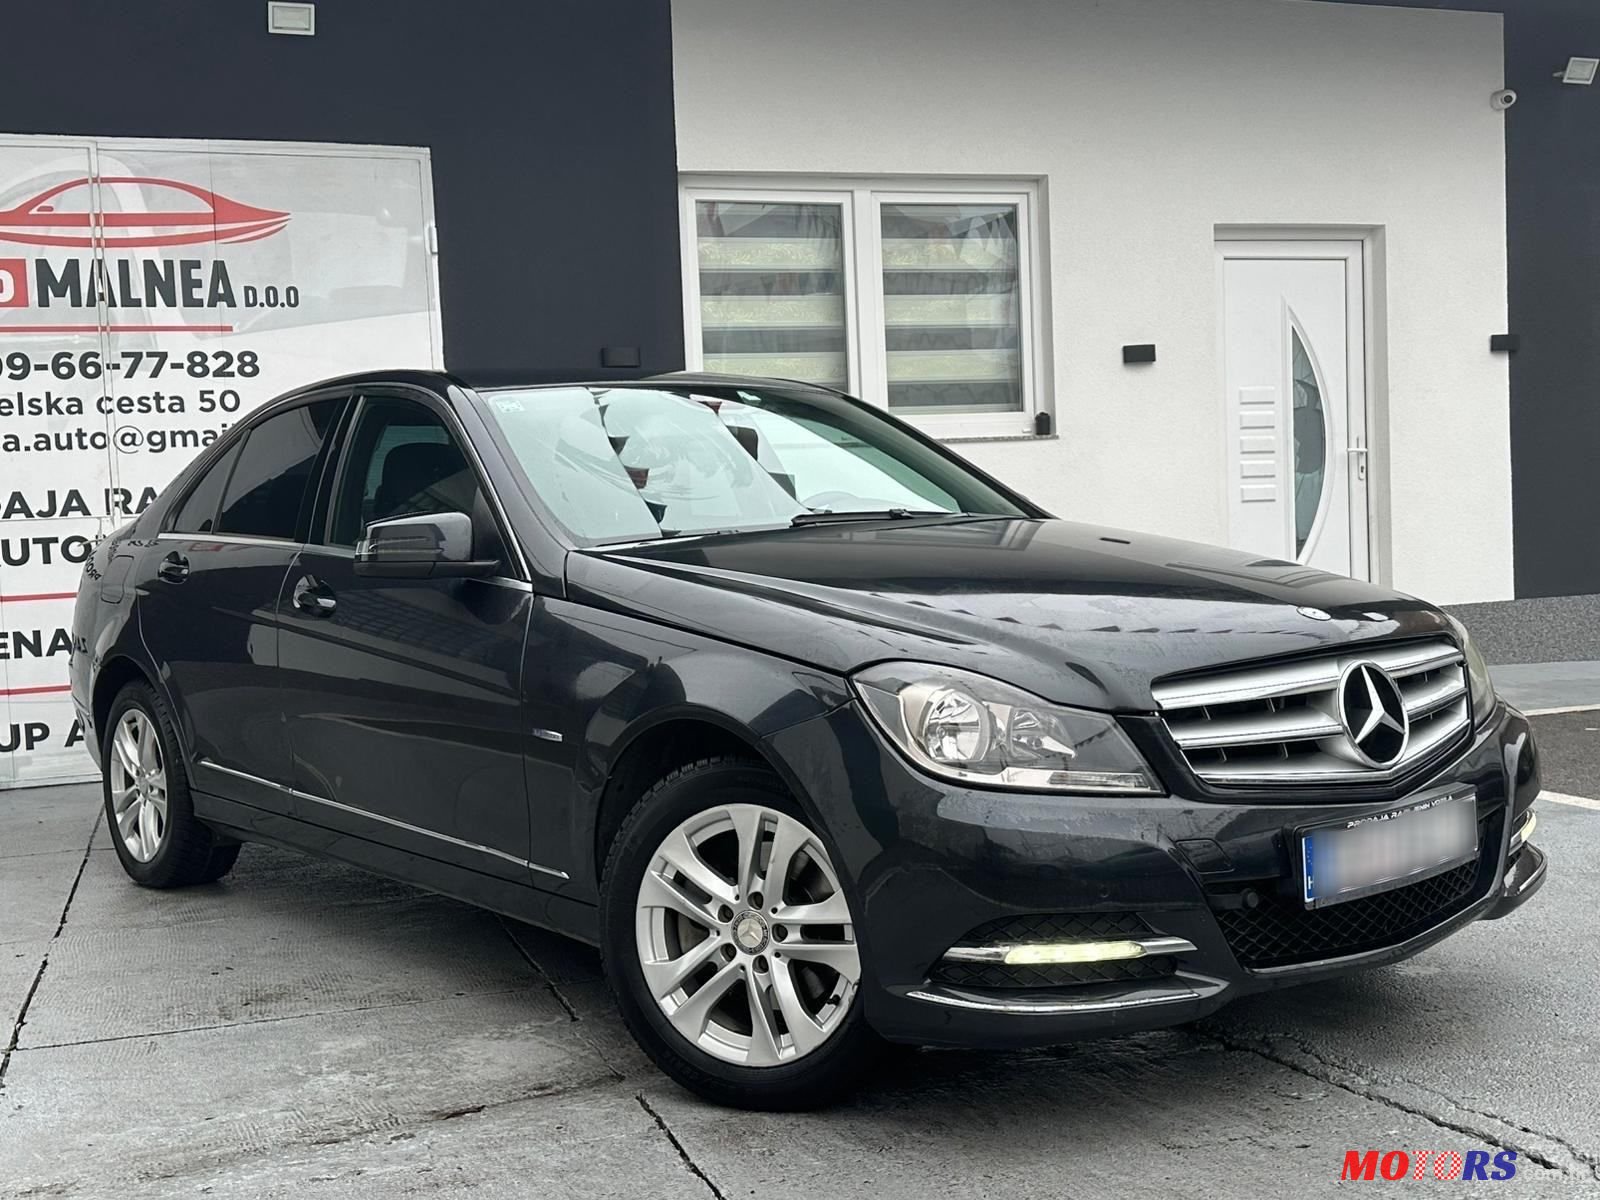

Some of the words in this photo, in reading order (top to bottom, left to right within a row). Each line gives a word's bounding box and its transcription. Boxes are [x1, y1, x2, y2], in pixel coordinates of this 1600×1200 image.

[35, 258, 237, 308] MALNEA
[244, 285, 300, 308] D.O.O
[0, 350, 260, 381] 9-66-77-828
[96, 391, 186, 415] cesta
[199, 389, 241, 412] 50
[0, 488, 92, 519] AJA
